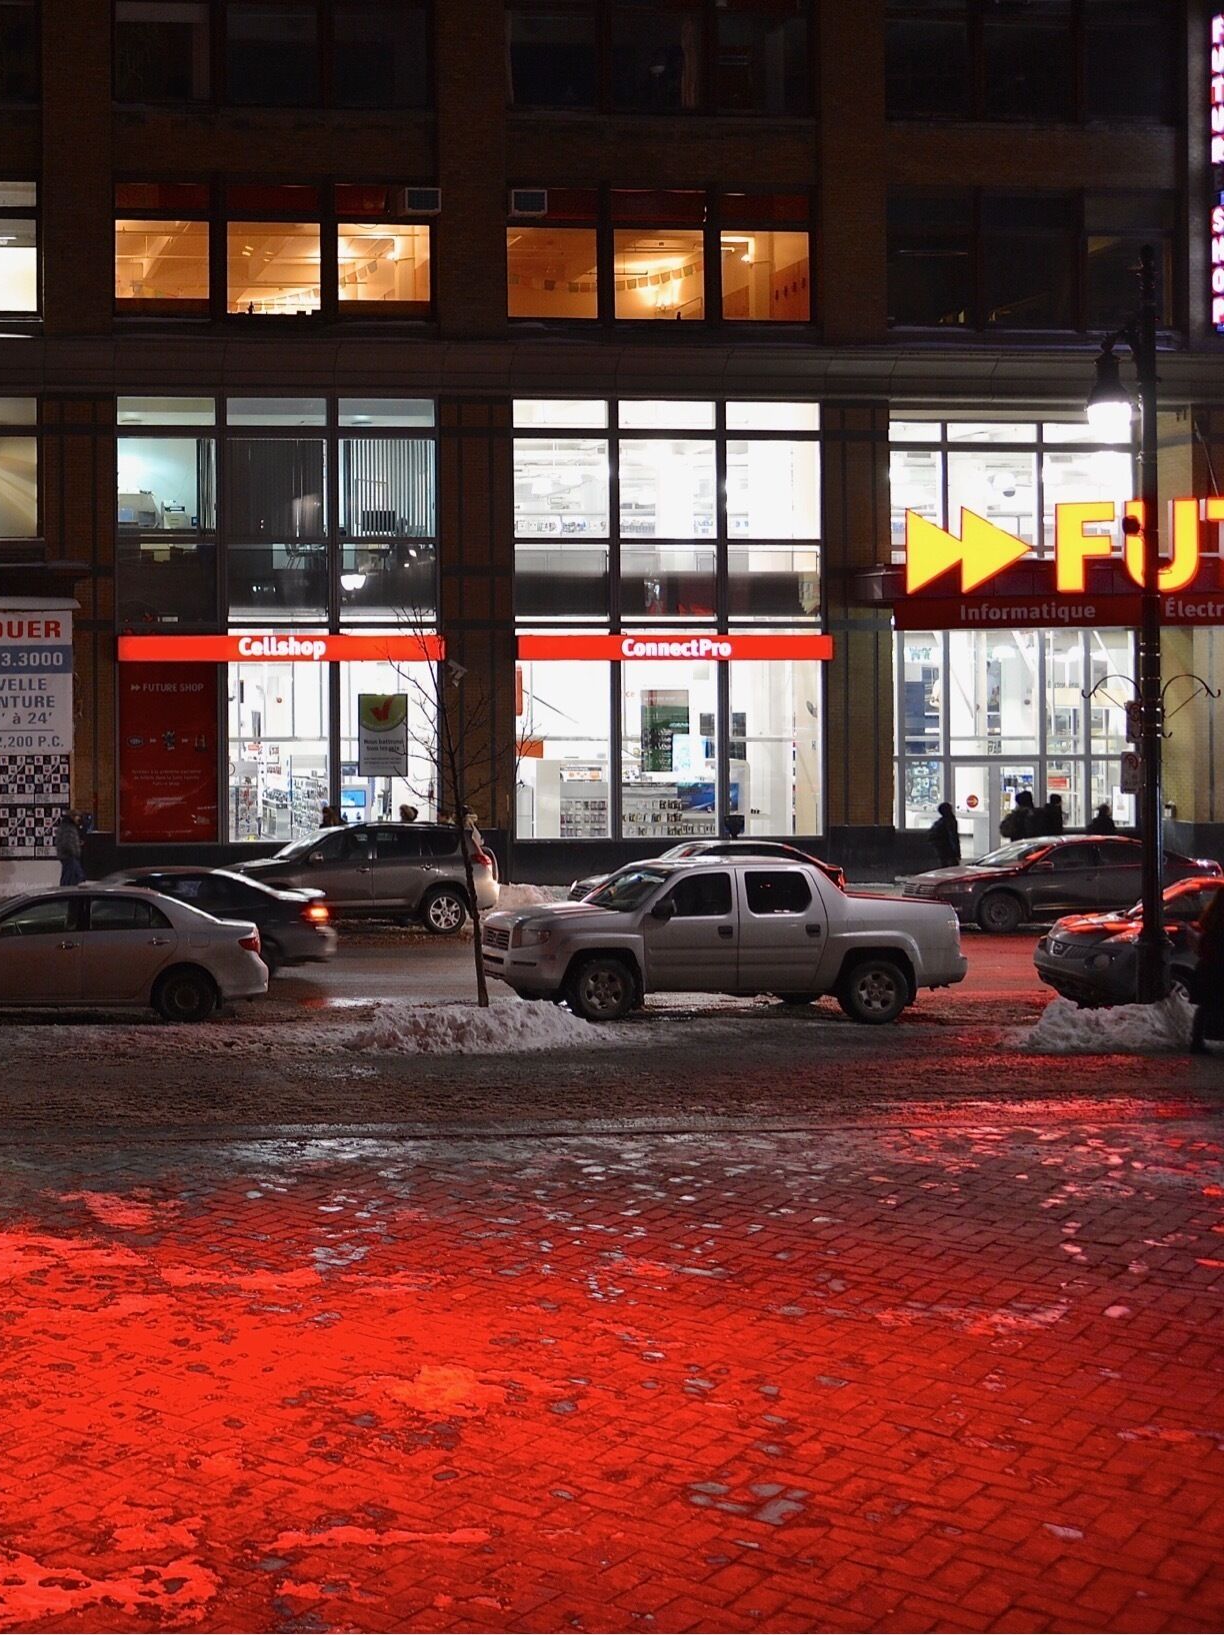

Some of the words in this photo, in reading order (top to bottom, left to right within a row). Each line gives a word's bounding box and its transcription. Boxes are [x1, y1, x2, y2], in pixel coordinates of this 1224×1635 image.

[960, 602, 1096, 623] Informatique
[238, 636, 326, 660] Cellshop
[142, 683, 177, 692] FUTURE
[179, 683, 204, 692] SHOP
[12, 712, 21, 725] à
[38, 735, 64, 747] P.C.
